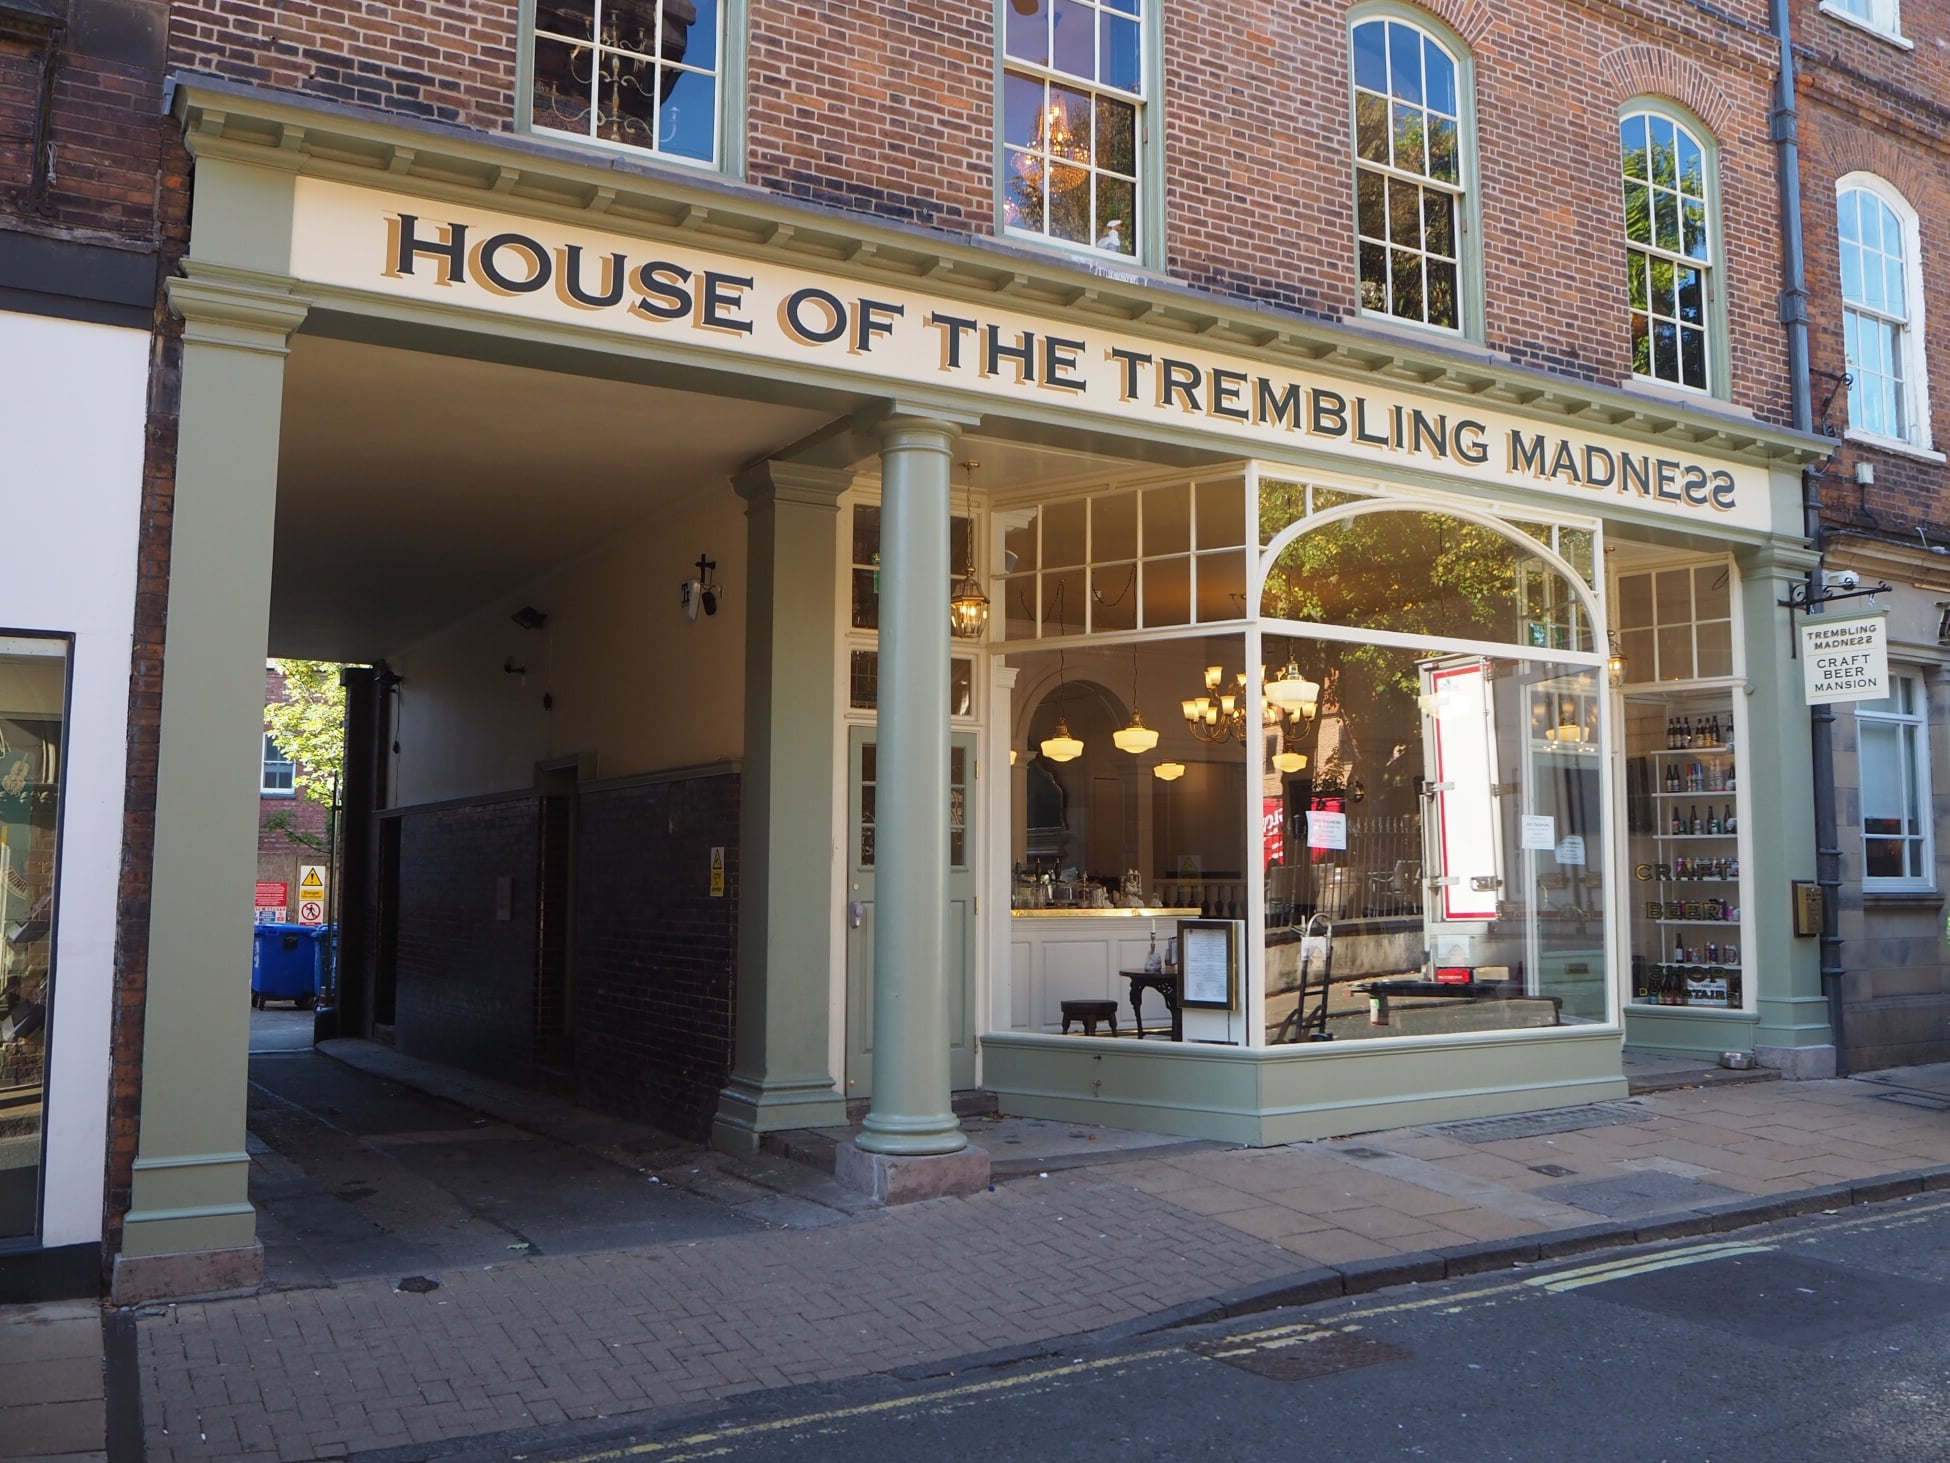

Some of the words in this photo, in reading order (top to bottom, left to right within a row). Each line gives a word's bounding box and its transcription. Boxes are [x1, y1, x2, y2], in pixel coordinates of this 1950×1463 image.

[381, 212, 753, 337] HOUSE
[776, 288, 904, 355] OF
[923, 310, 1087, 396] THE
[1105, 346, 1489, 464] TREMBLING
[1808, 624, 1877, 641] TREMBLING
[1817, 654, 1871, 669] CRAFT
[1824, 667, 1865, 680] BEER
[1815, 678, 1877, 692] MANSION
[1635, 863, 1731, 882] CRAFT
[1646, 902, 1722, 921] BEER
[1649, 964, 1728, 984] SHOP
